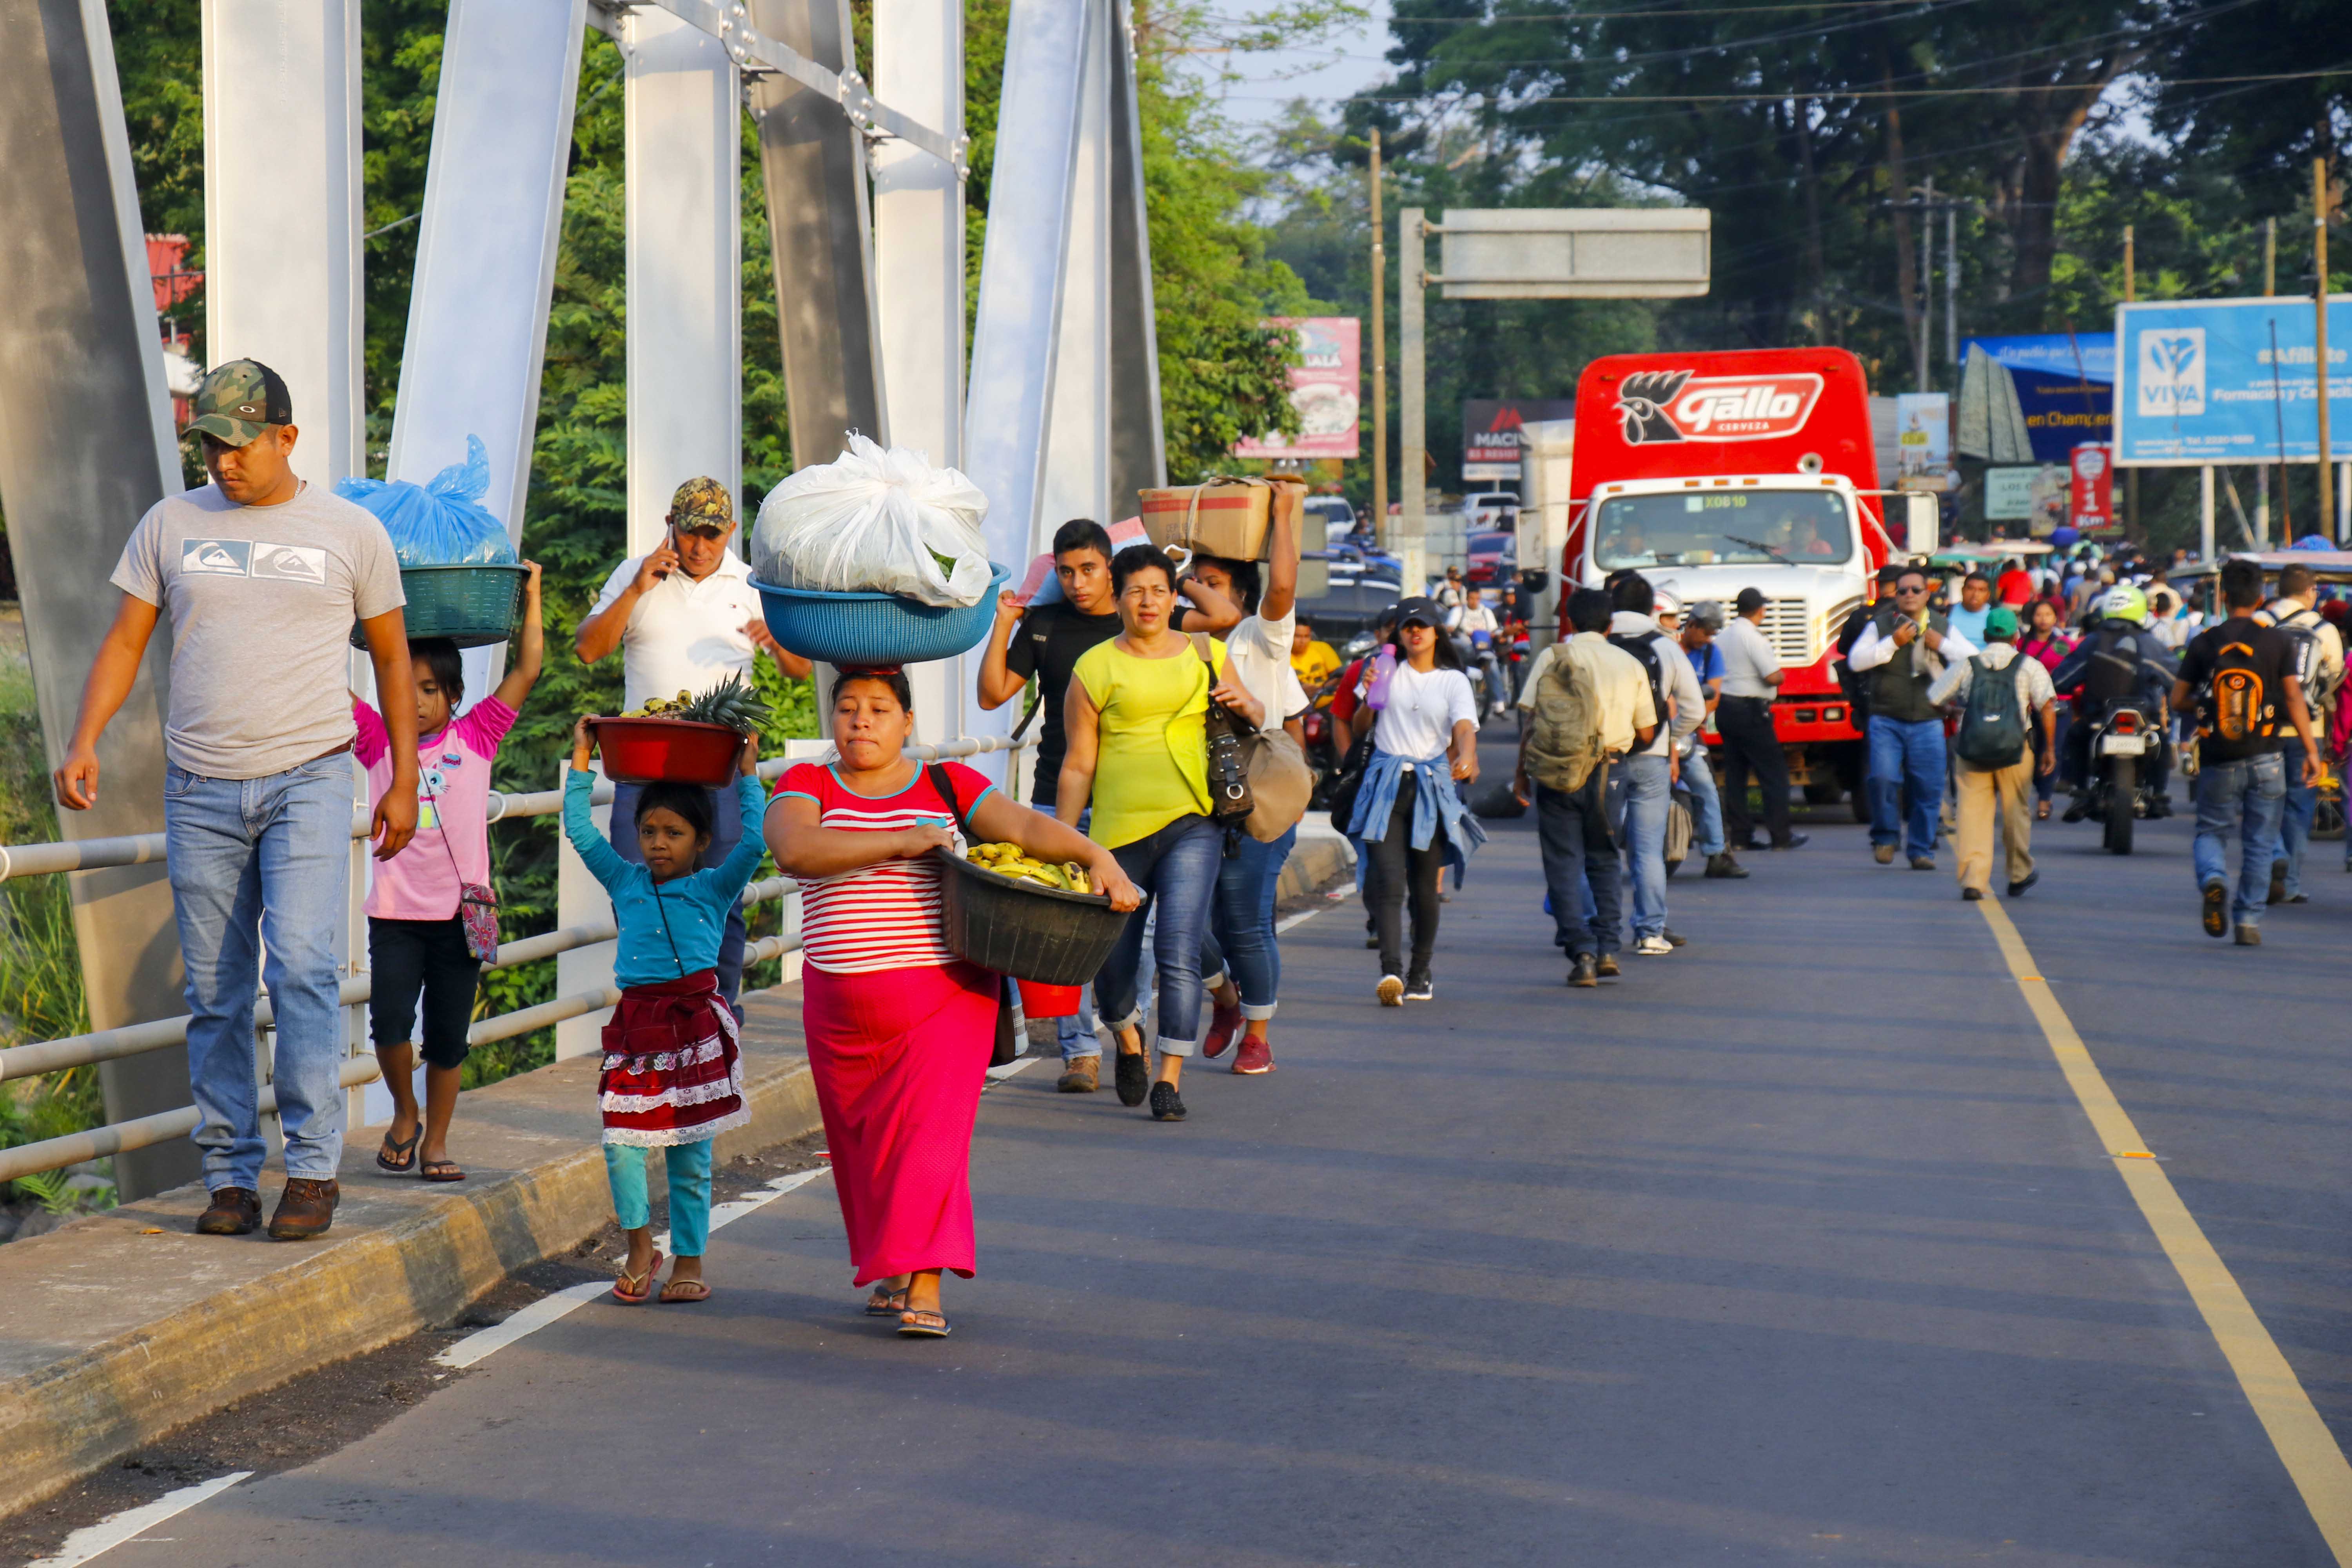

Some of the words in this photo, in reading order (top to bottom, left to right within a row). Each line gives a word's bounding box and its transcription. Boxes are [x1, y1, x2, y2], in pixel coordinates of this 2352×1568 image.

[2144, 385, 2200, 403] VIVA
[1719, 422, 1769, 432] CERVEZA
[2083, 492, 2099, 512] 1
[2077, 515, 2104, 526] Km
